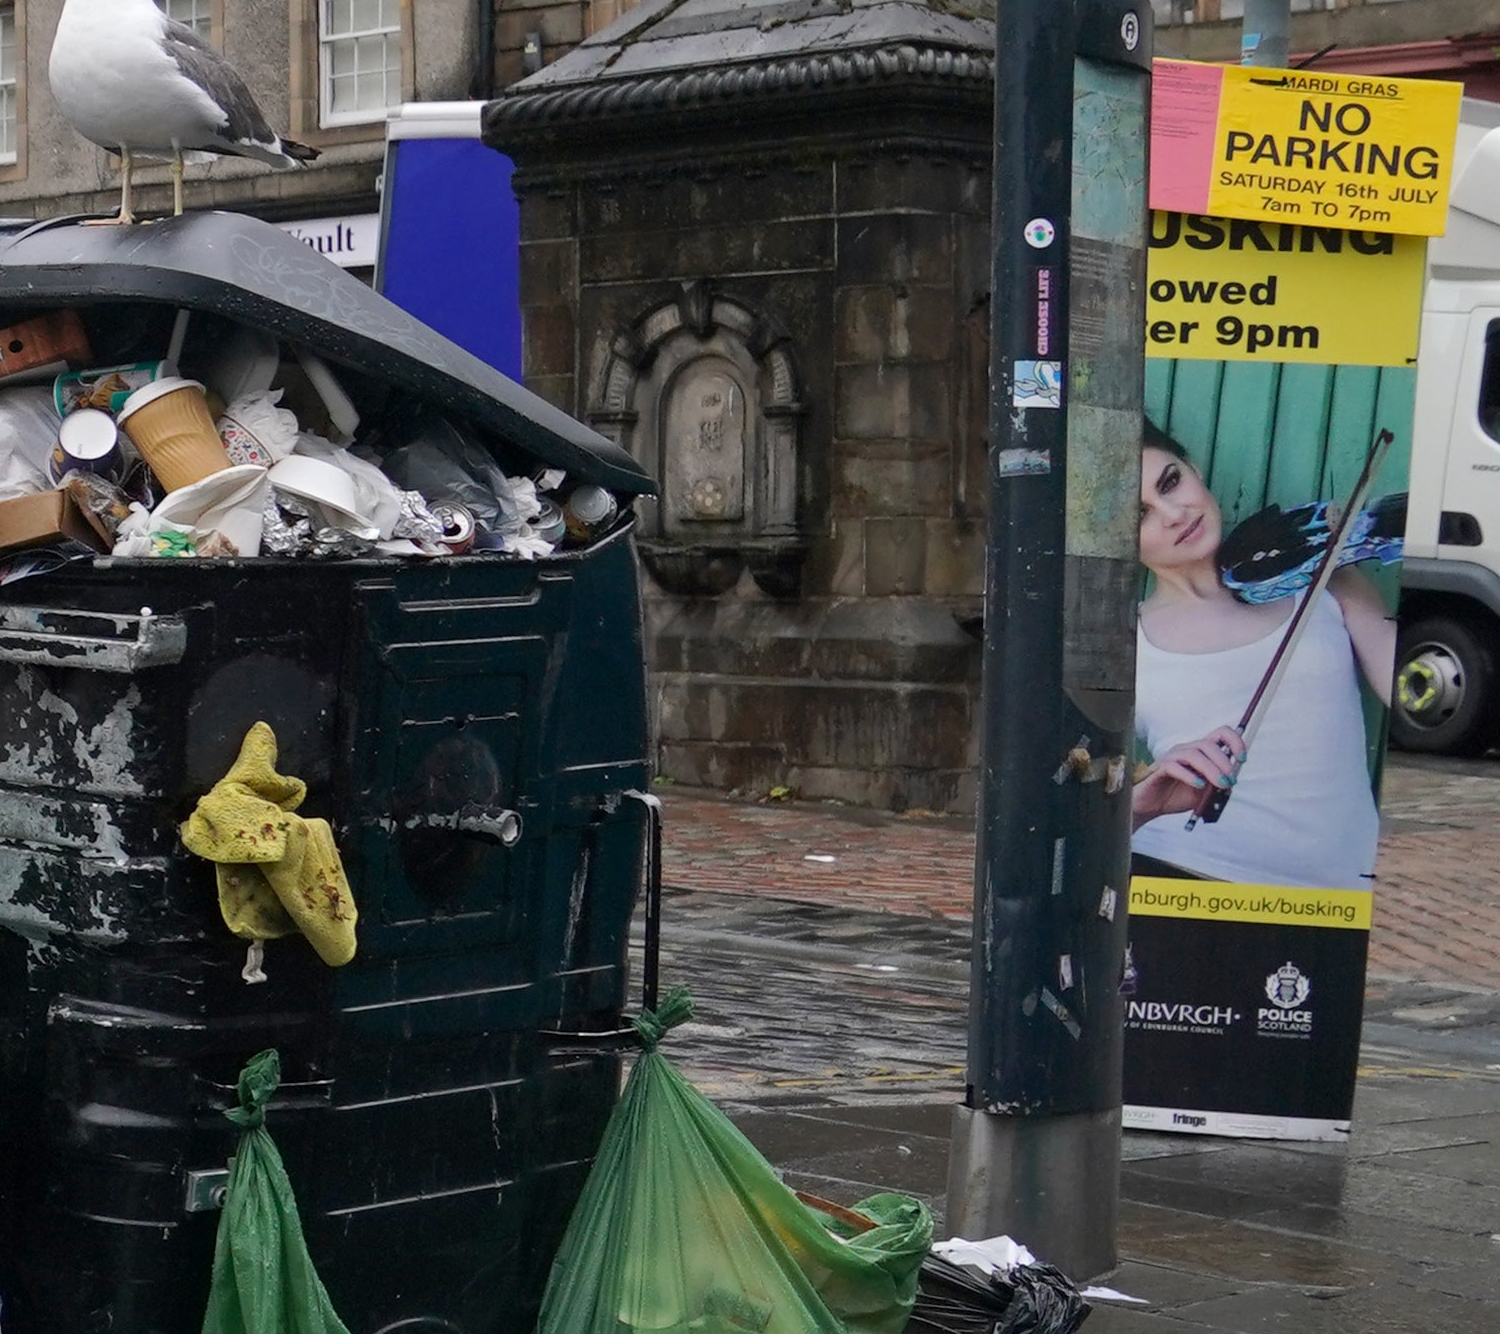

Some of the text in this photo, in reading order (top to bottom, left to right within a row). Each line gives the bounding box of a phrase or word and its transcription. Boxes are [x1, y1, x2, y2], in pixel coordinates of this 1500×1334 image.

[1280, 75, 1399, 97] MARDI GRAS
[1298, 99, 1371, 137] NO
[1224, 130, 1440, 181] PARKING
[1219, 171, 1439, 205] SATURDAY 16th JULY
[1260, 196, 1392, 224] 7am TO 7pm
[1036, 268, 1051, 356] CHOOSE LIFE
[1214, 315, 1320, 353] 9pm
[1141, 1022, 1189, 1033] EDINBURGH
[1257, 1007, 1313, 1024] POLICE
[1257, 1020, 1312, 1033] SCOTLAND
[1172, 1112, 1207, 1127] fringe
